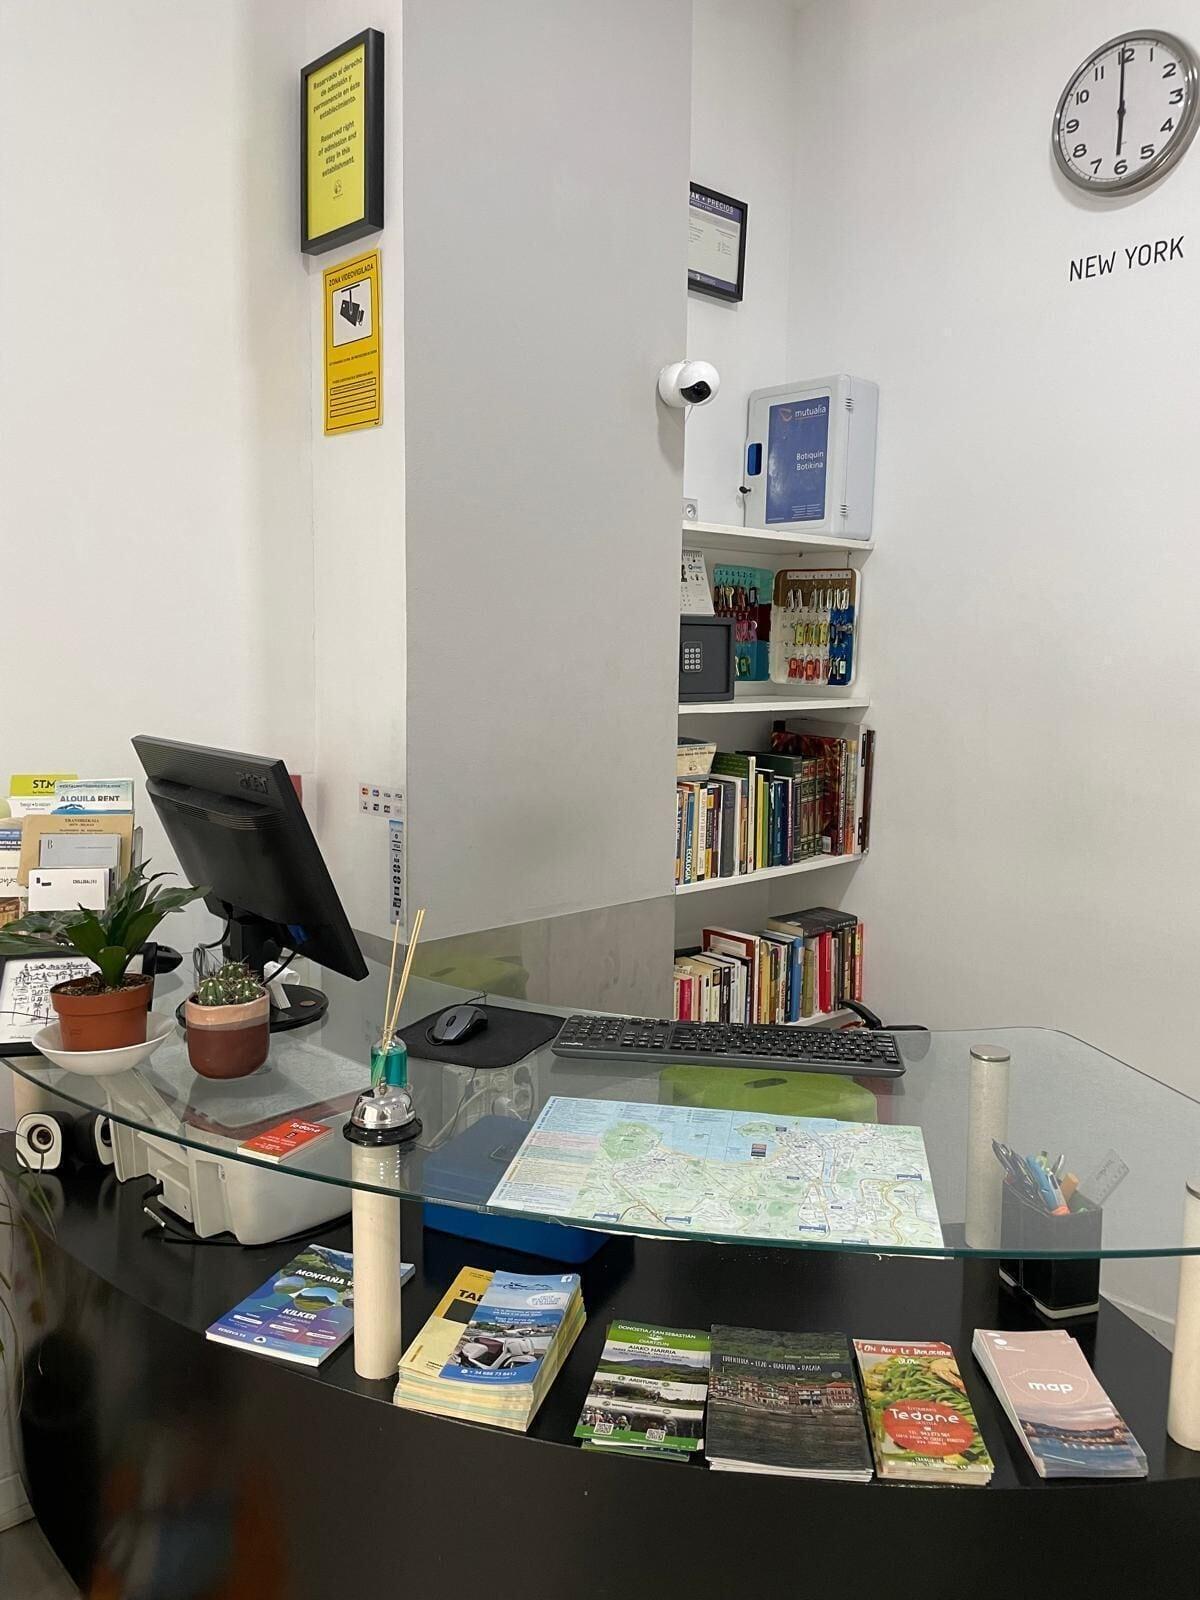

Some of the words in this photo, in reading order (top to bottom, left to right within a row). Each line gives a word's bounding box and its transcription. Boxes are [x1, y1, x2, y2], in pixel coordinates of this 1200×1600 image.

[1118, 47, 1135, 65] 12
[1150, 47, 1154, 62] 1
[313, 72, 337, 90] Reservado
[343, 57, 363, 73] derecho
[1094, 65, 1104, 82] 11
[1162, 62, 1177, 79] 2
[313, 91, 342, 114] permanencia
[1076, 89, 1090, 105] 10
[1169, 88, 1184, 105] 3
[320, 126, 342, 143] Reserved
[342, 120, 355, 132] right
[1066, 119, 1079, 134] 9
[1160, 117, 1174, 132] 4
[324, 137, 347, 154] admission
[348, 131, 357, 141] and
[1072, 143, 1087, 158] 8
[325, 155, 336, 165] stay
[341, 147, 351, 156] this
[1140, 144, 1155, 160] 5
[1090, 158, 1102, 174] 7
[1113, 159, 1128, 175] 6
[707, 196, 734, 213] PRECIOS
[1069, 250, 1116, 282] NEW
[1125, 235, 1184, 269] YORK
[328, 278, 341, 287] ZONA
[341, 263, 374, 281] VIDEOVIGILADA
[795, 404, 827, 418] mutualia
[796, 460, 824, 471] Botikina
[295, 1268, 345, 1285] MONTAÑA
[282, 1307, 317, 1321] KILKER
[650, 1347, 676, 1355] HARRIA
[1028, 1381, 1073, 1394] map
[889, 1408, 960, 1424] Tedone
